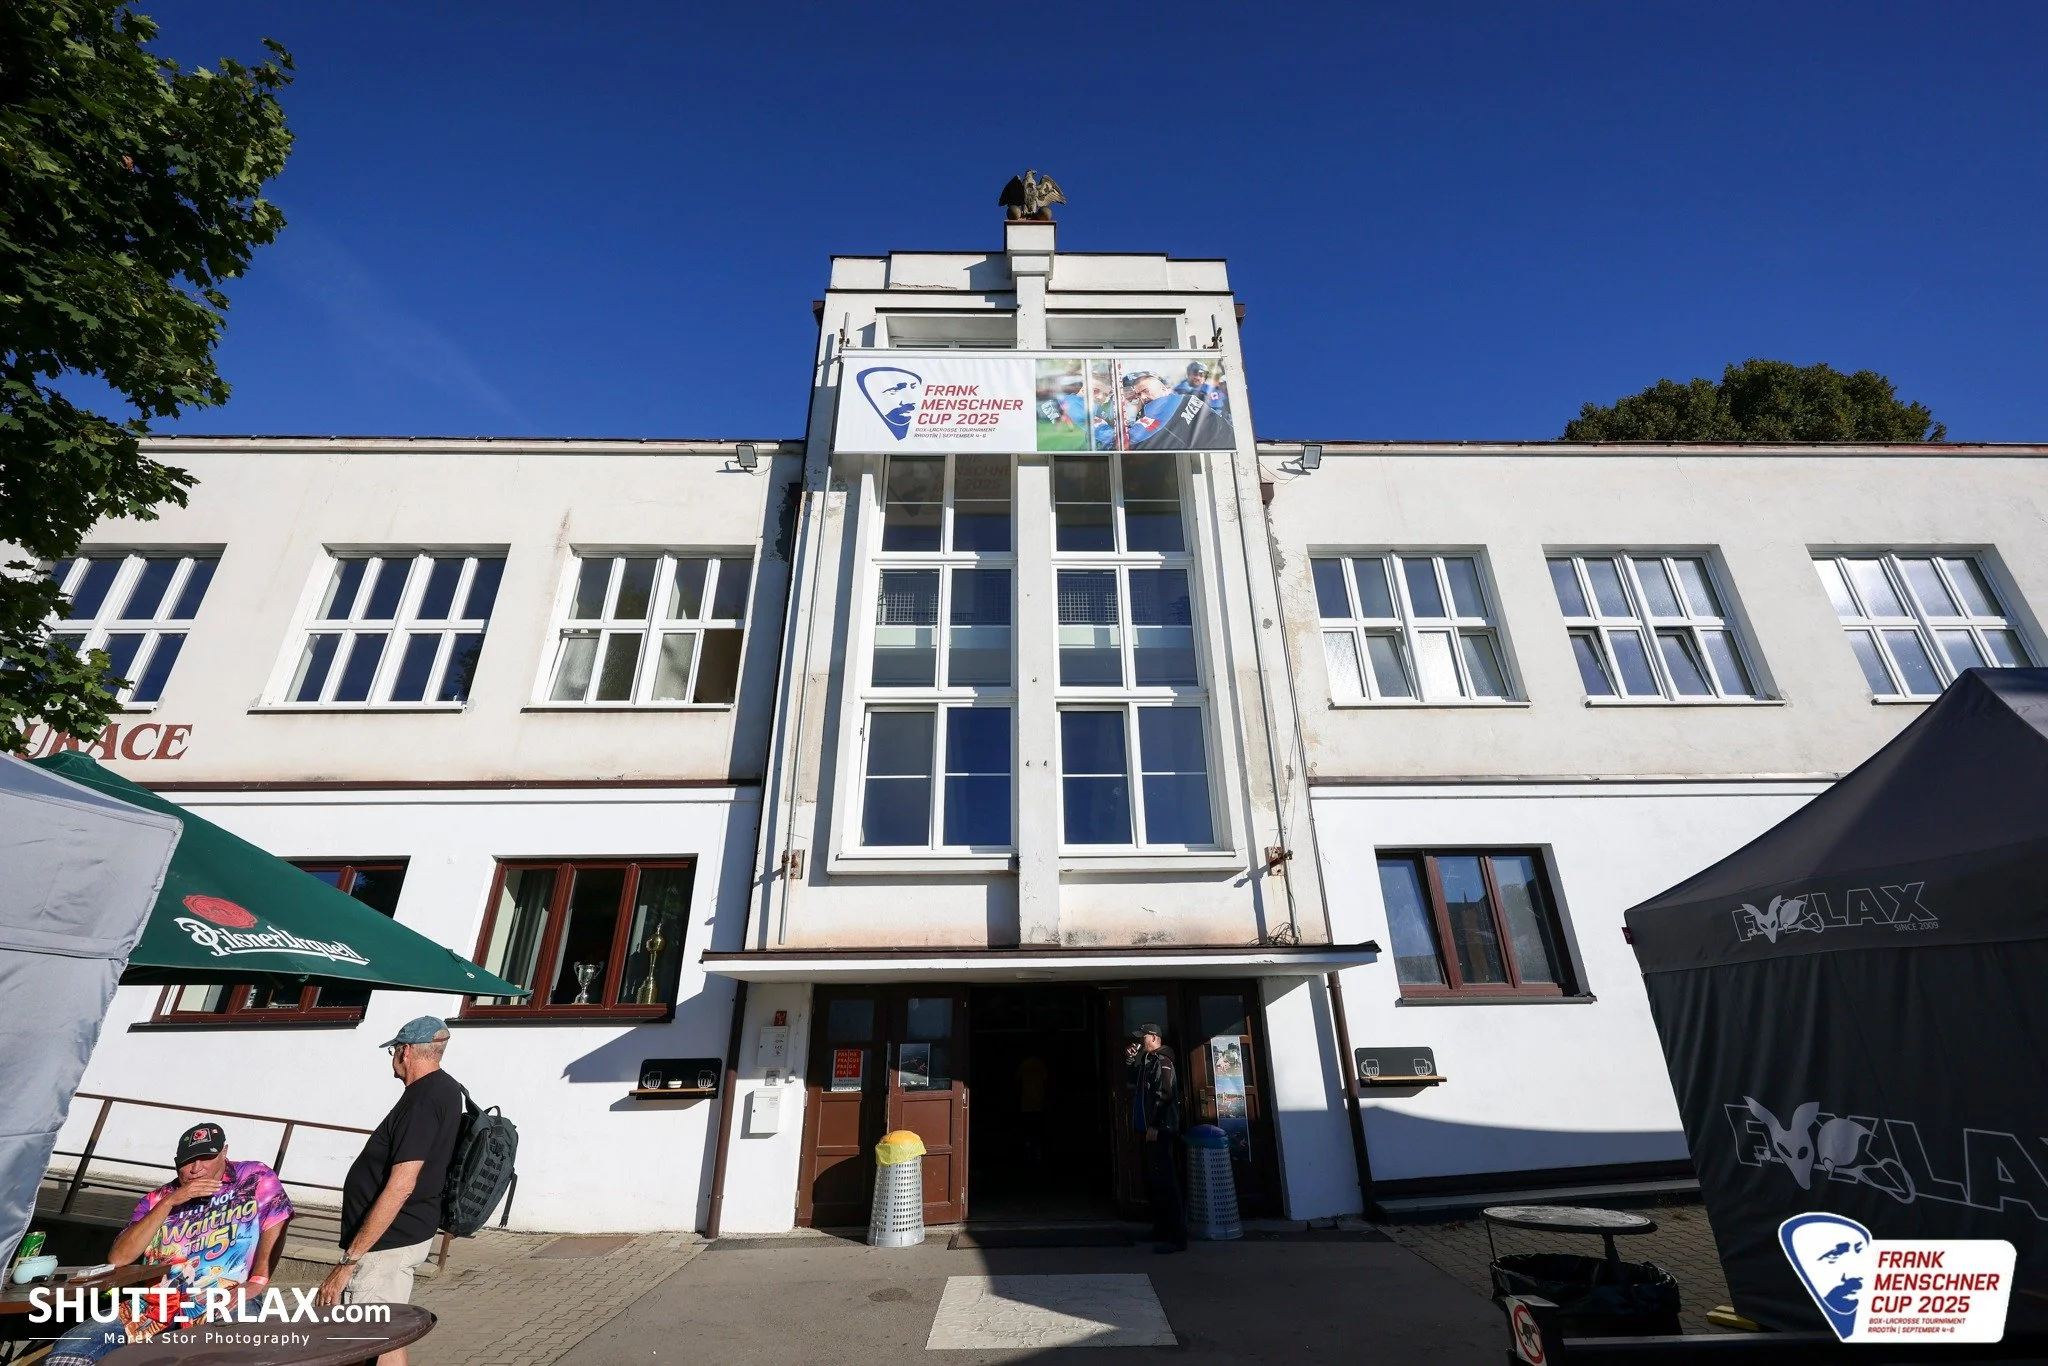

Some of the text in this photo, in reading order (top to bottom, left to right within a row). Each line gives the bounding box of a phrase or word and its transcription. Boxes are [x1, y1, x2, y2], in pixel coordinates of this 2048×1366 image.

[925, 385, 979, 396] FRANK
[921, 399, 1024, 411] MENSCHNER
[917, 413, 1000, 425] CUP 2025
[1894, 921, 1939, 932] SINCE 2009
[173, 917, 371, 966] Pilsner Urquell
[210, 1190, 235, 1208] Not
[161, 1200, 258, 1246] Waiting
